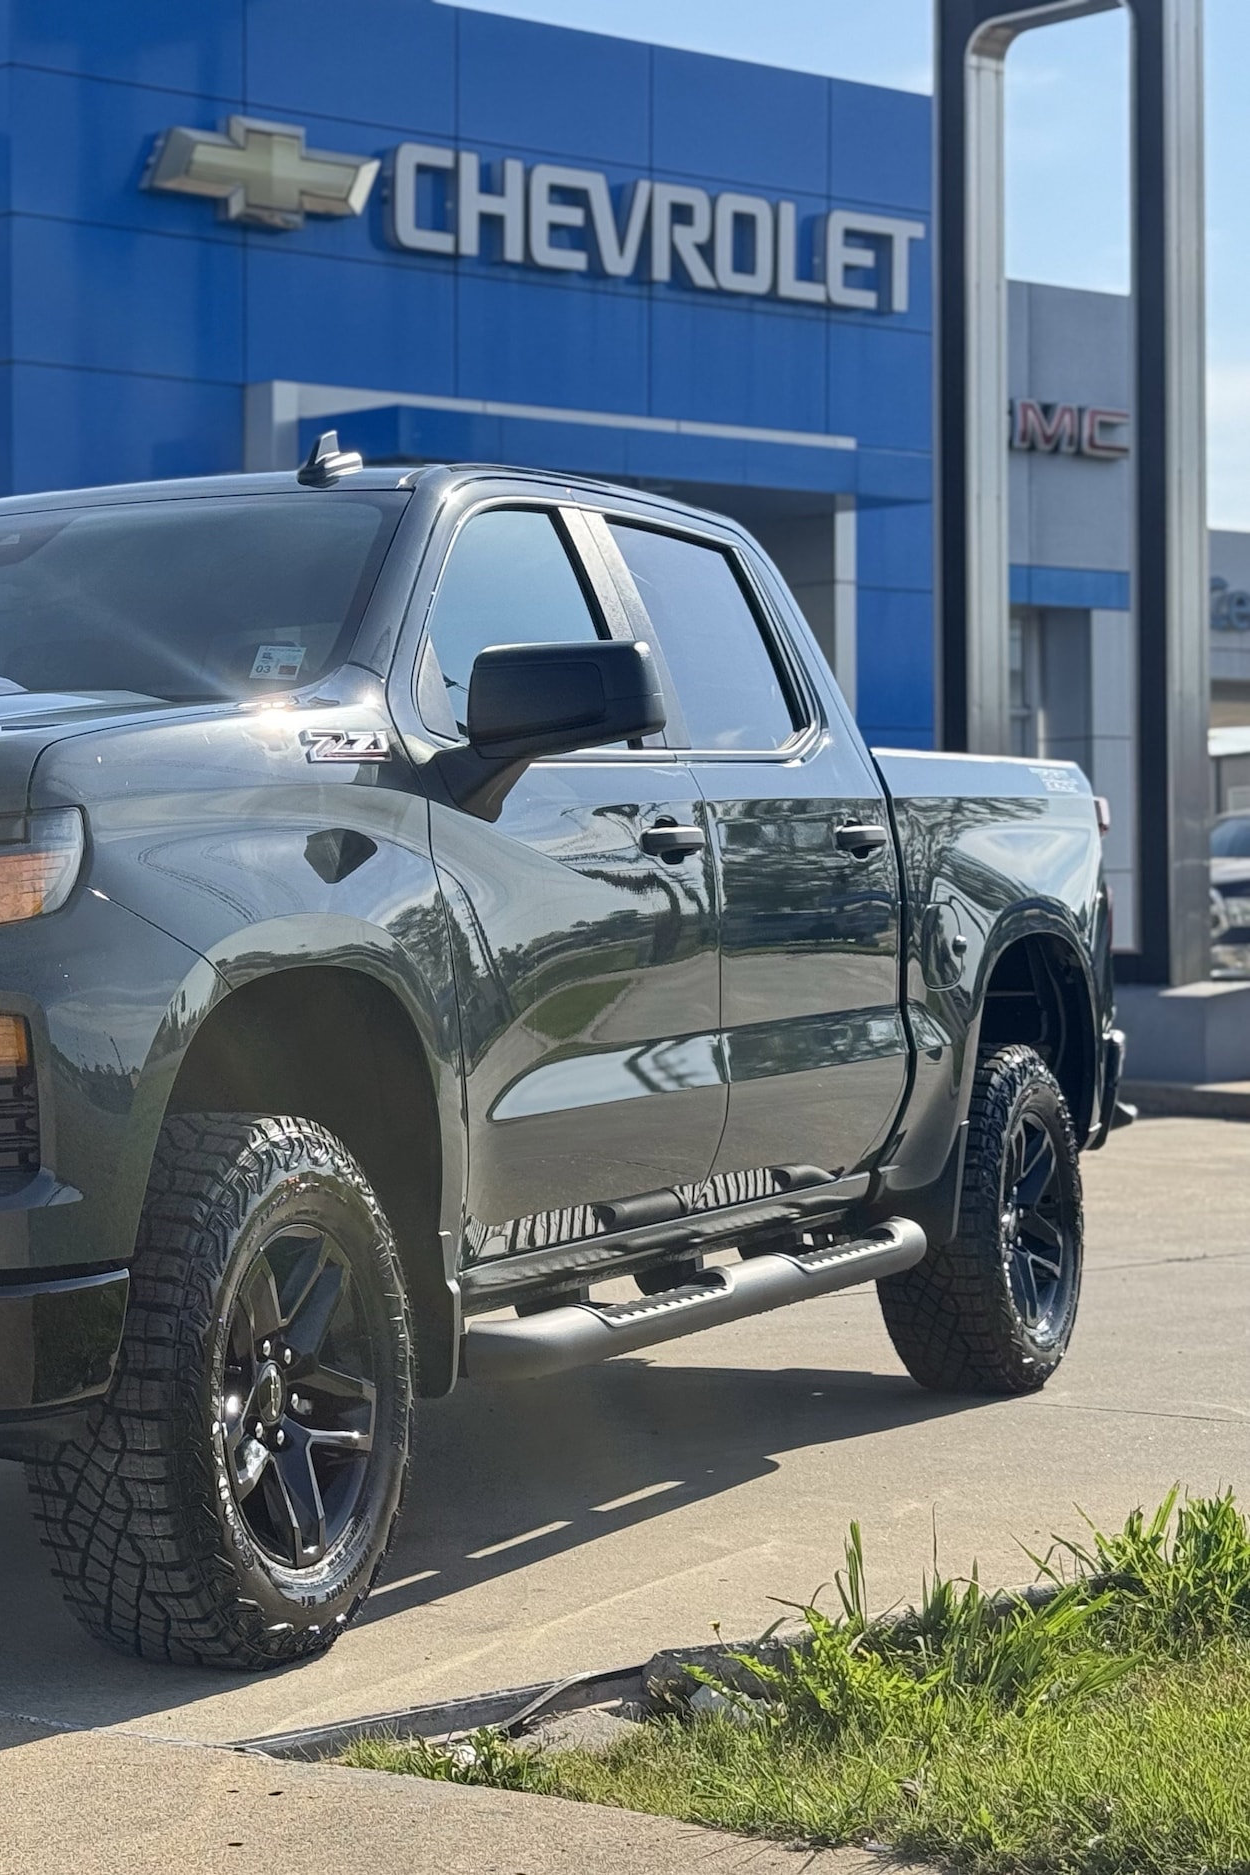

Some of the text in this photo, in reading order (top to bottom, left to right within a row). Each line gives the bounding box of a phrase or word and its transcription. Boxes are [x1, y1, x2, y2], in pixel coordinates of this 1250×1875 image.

[393, 141, 925, 314] CHEVROLET
[1010, 400, 1131, 459] MC
[298, 729, 392, 763] Z71
